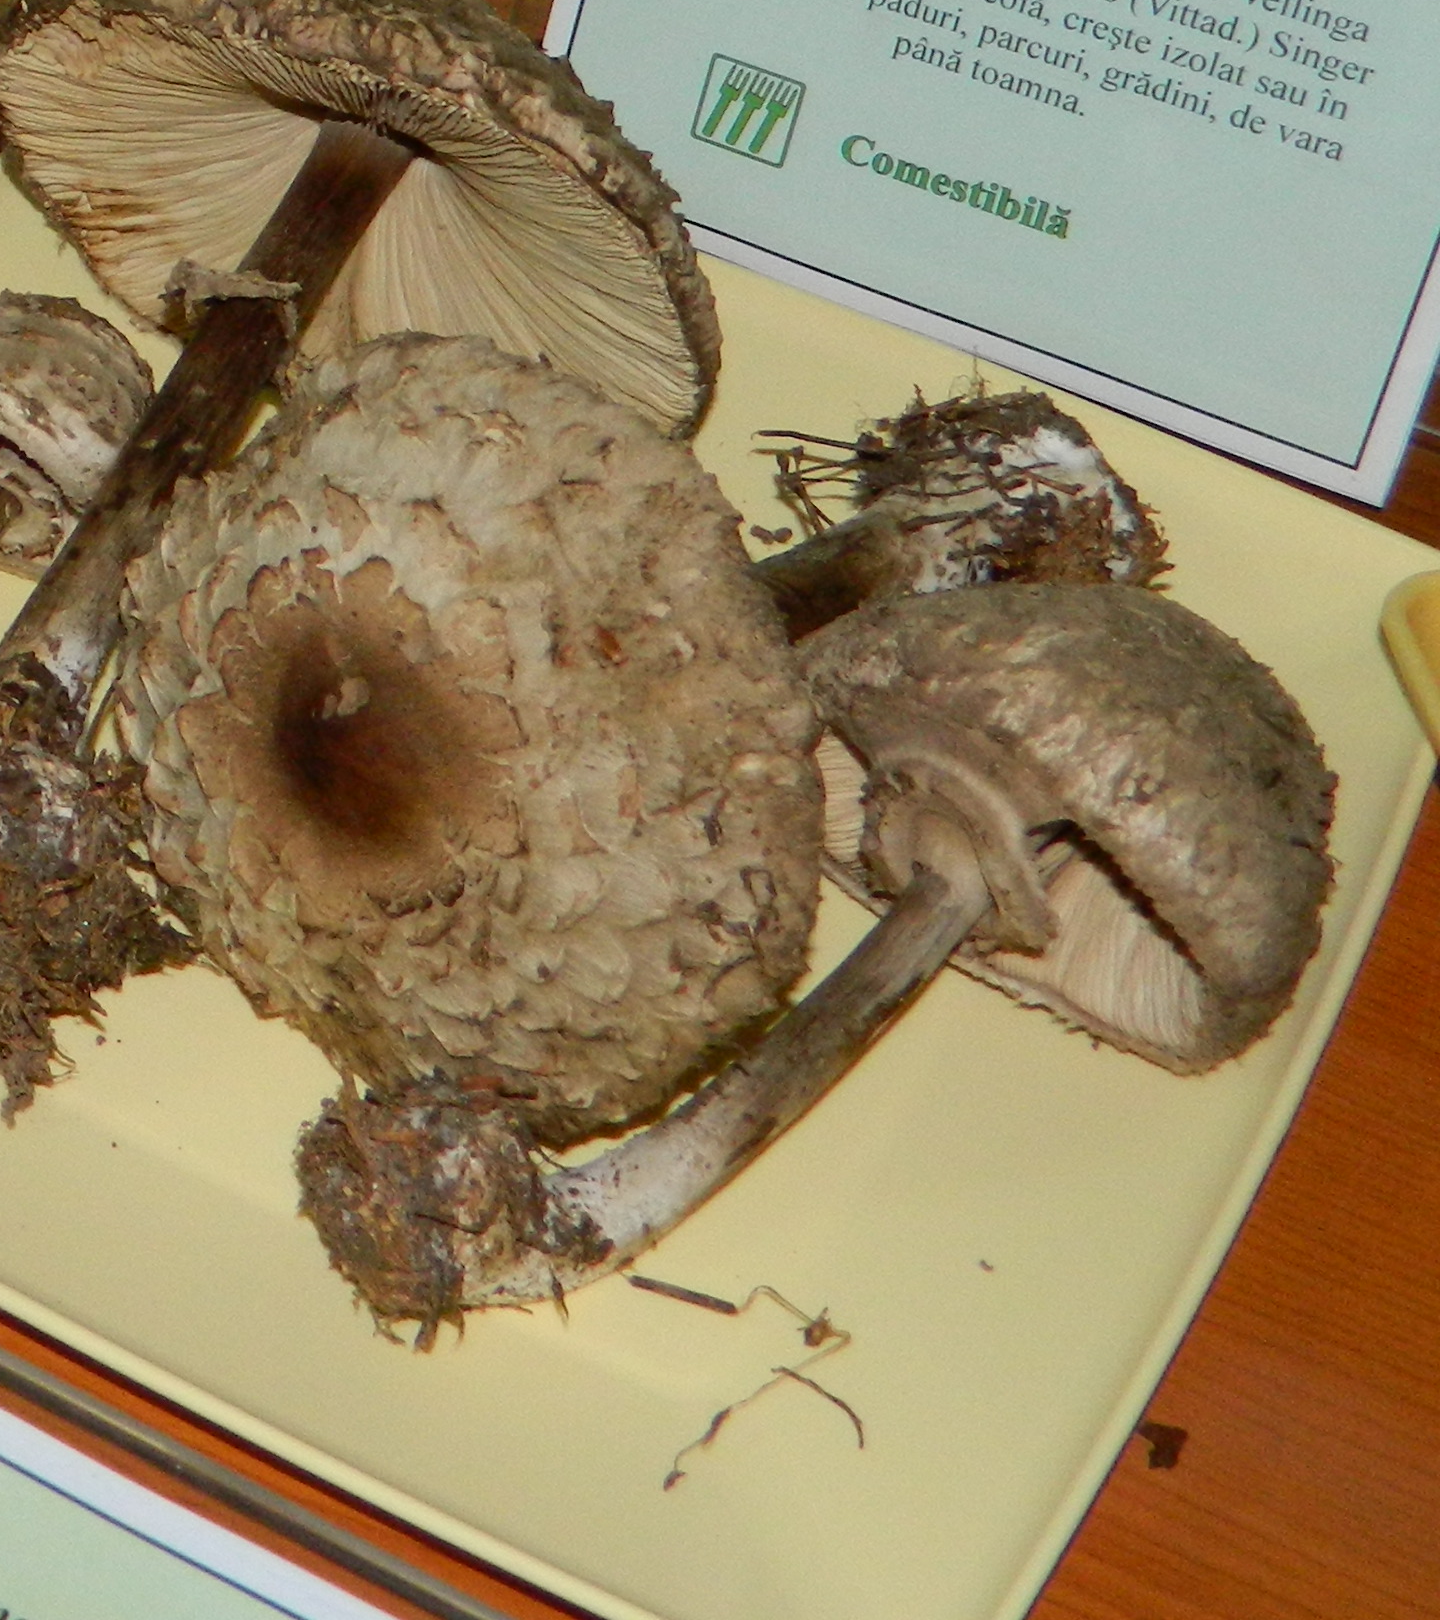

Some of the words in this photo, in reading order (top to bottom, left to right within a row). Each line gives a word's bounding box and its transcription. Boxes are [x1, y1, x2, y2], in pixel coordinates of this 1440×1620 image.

[890, 35, 963, 75] până
[970, 58, 1086, 118] toamna.
[975, 24, 1091, 81] parcuri,
[1098, 66, 1217, 124] grădini,
[1228, 103, 1268, 136] de
[1279, 123, 1344, 163] vara
[1160, 35, 1247, 87] izolat
[1253, 74, 1308, 108] sau
[1317, 87, 1349, 121] în
[1268, 30, 1376, 85] Singer
[839, 133, 1073, 241] Comestibilă
